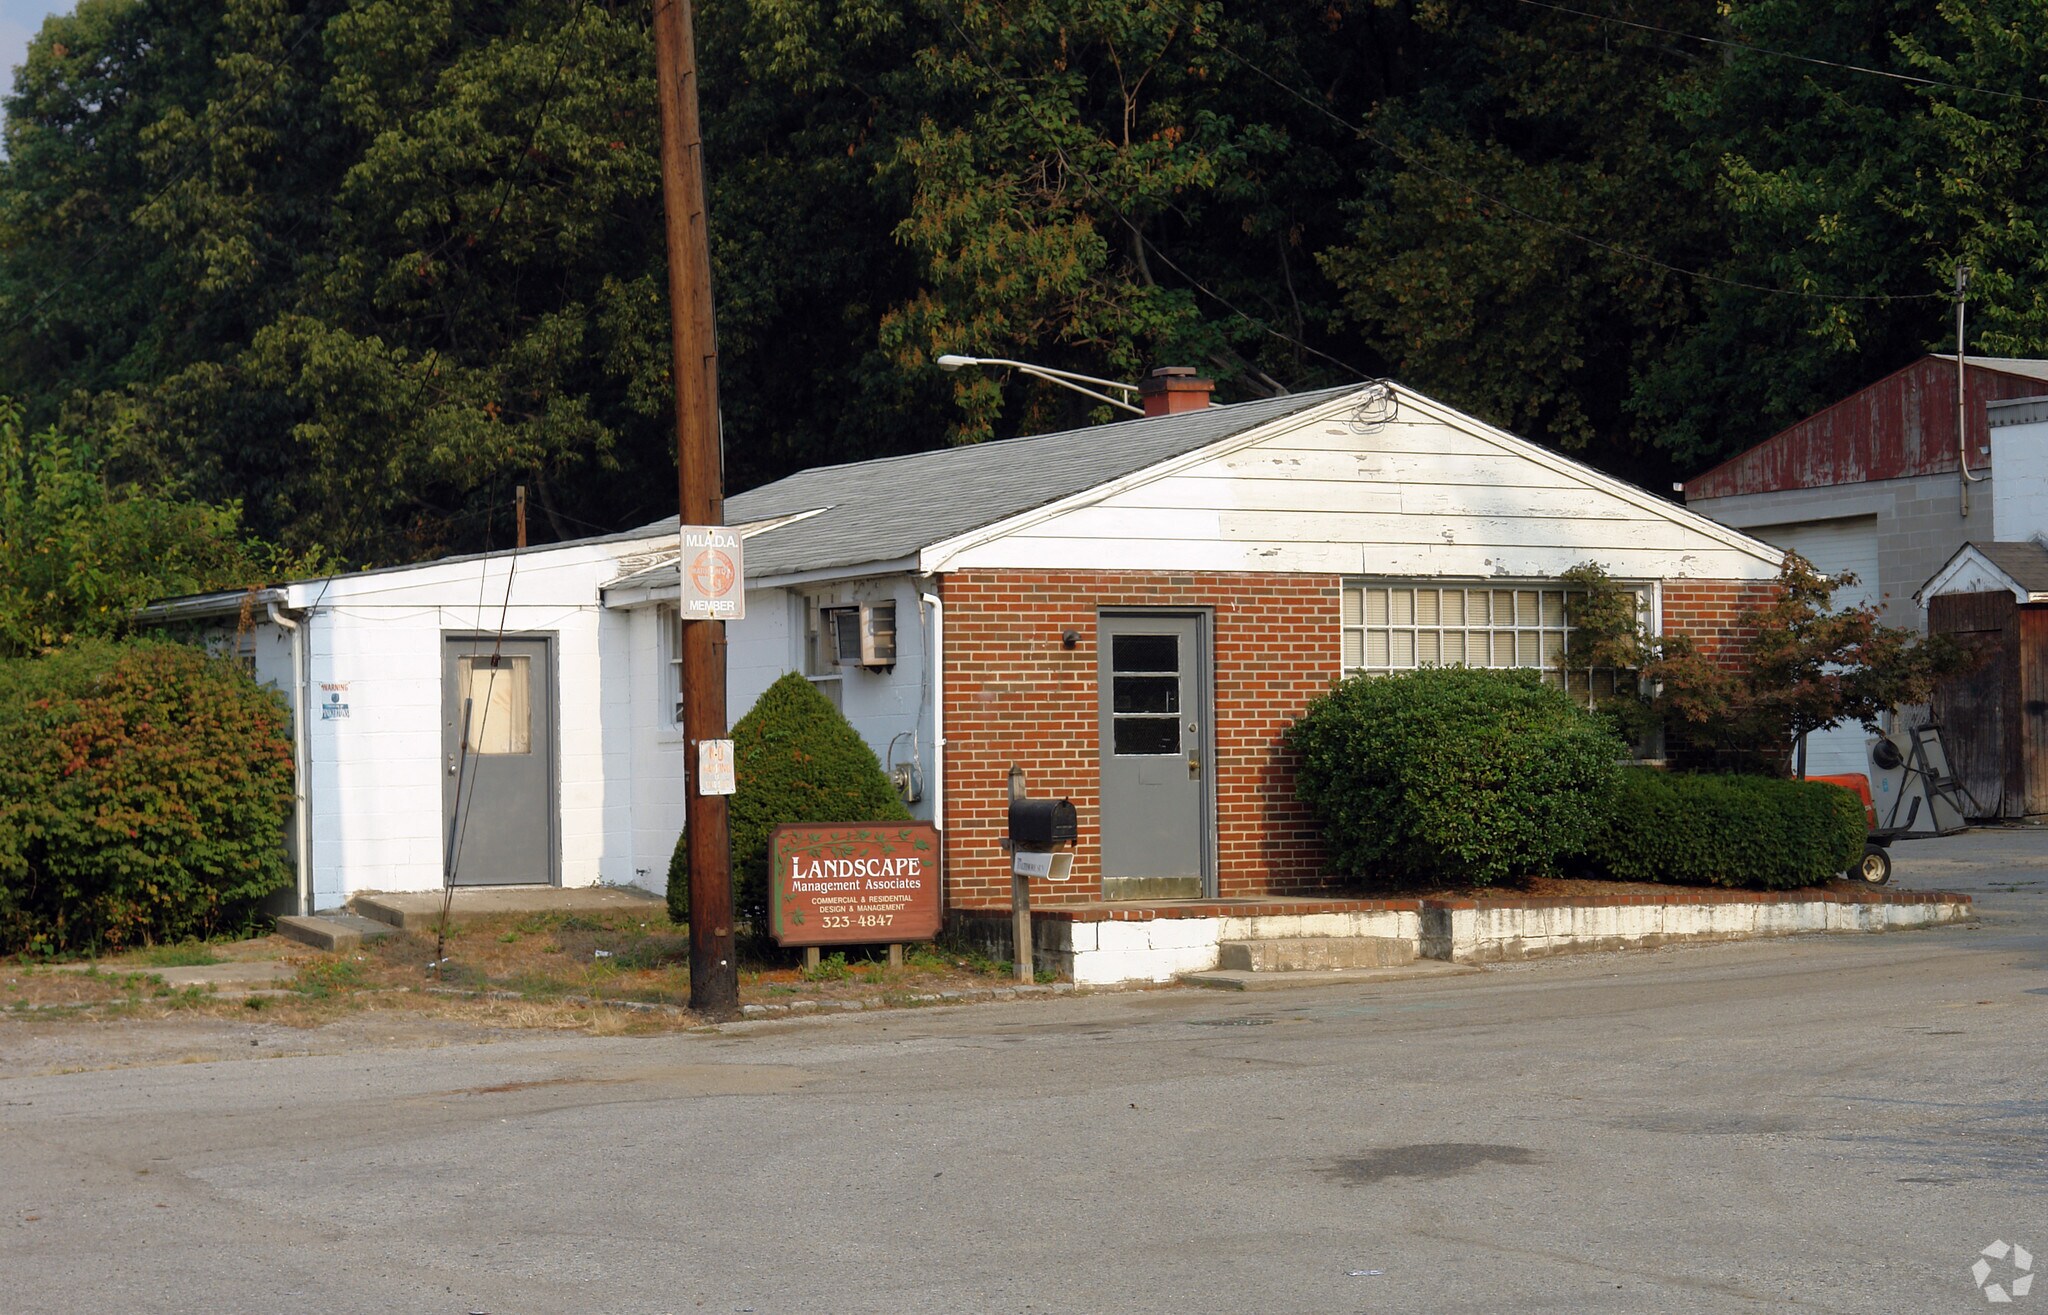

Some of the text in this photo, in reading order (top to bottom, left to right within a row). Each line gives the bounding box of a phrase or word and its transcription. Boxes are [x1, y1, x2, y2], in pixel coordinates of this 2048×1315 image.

[689, 600, 735, 611] MEMBER
[321, 683, 349, 691] WARNING
[792, 856, 921, 879] LANDSCAPE
[792, 878, 921, 894] Management Associates
[811, 896, 858, 905] COMMERCIAL
[869, 895, 913, 903] RESIDENTIAL
[819, 905, 846, 913] DESIGN
[857, 904, 905, 912] MANAGEMENT
[822, 914, 894, 928] 323-4847
